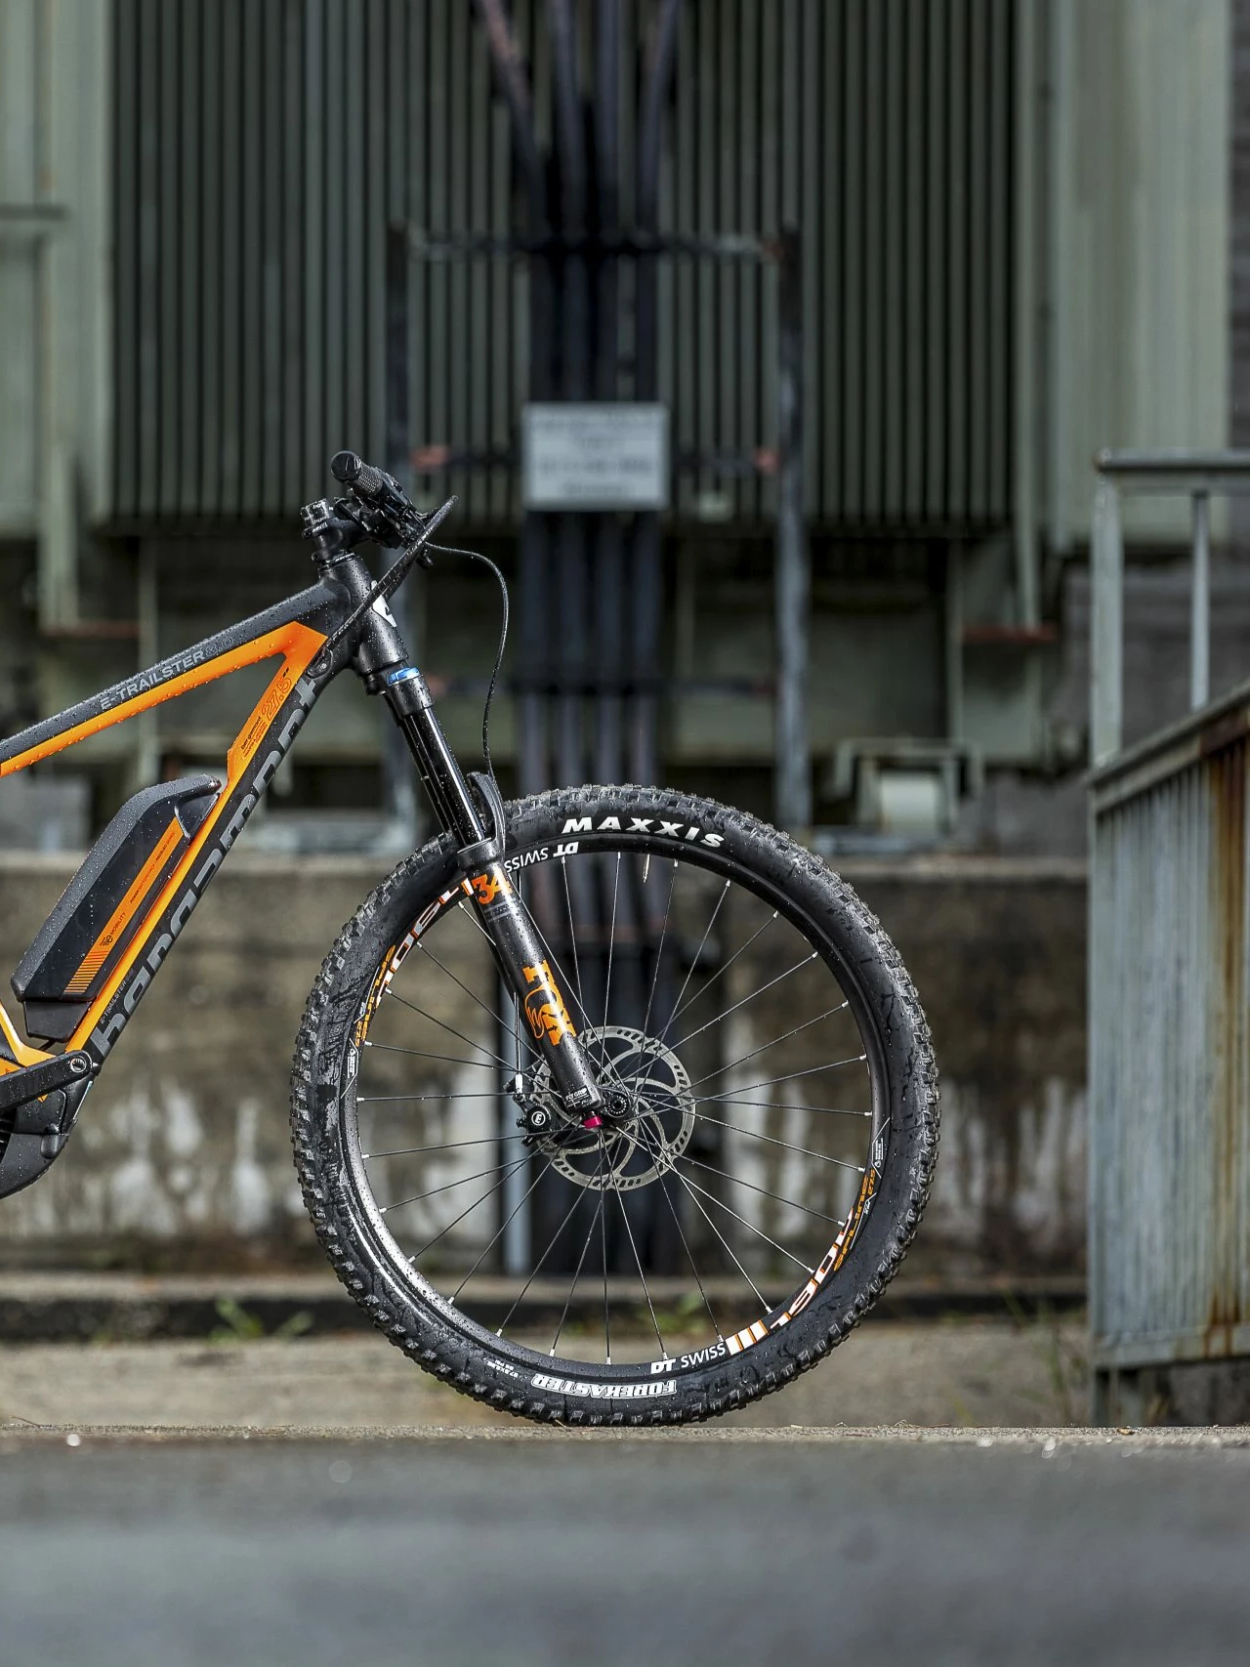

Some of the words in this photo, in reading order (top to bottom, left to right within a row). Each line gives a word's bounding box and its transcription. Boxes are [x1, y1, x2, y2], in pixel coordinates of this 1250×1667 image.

[99, 650, 205, 710] E-TRAILSTER
[561, 816, 726, 848] MAXXIS
[504, 846, 549, 873] SWISS
[552, 841, 579, 858] DT
[471, 873, 513, 905] 34
[650, 1358, 676, 1374] DT
[680, 1342, 726, 1368] SWISS
[531, 1372, 677, 1399] FOREKASTER
